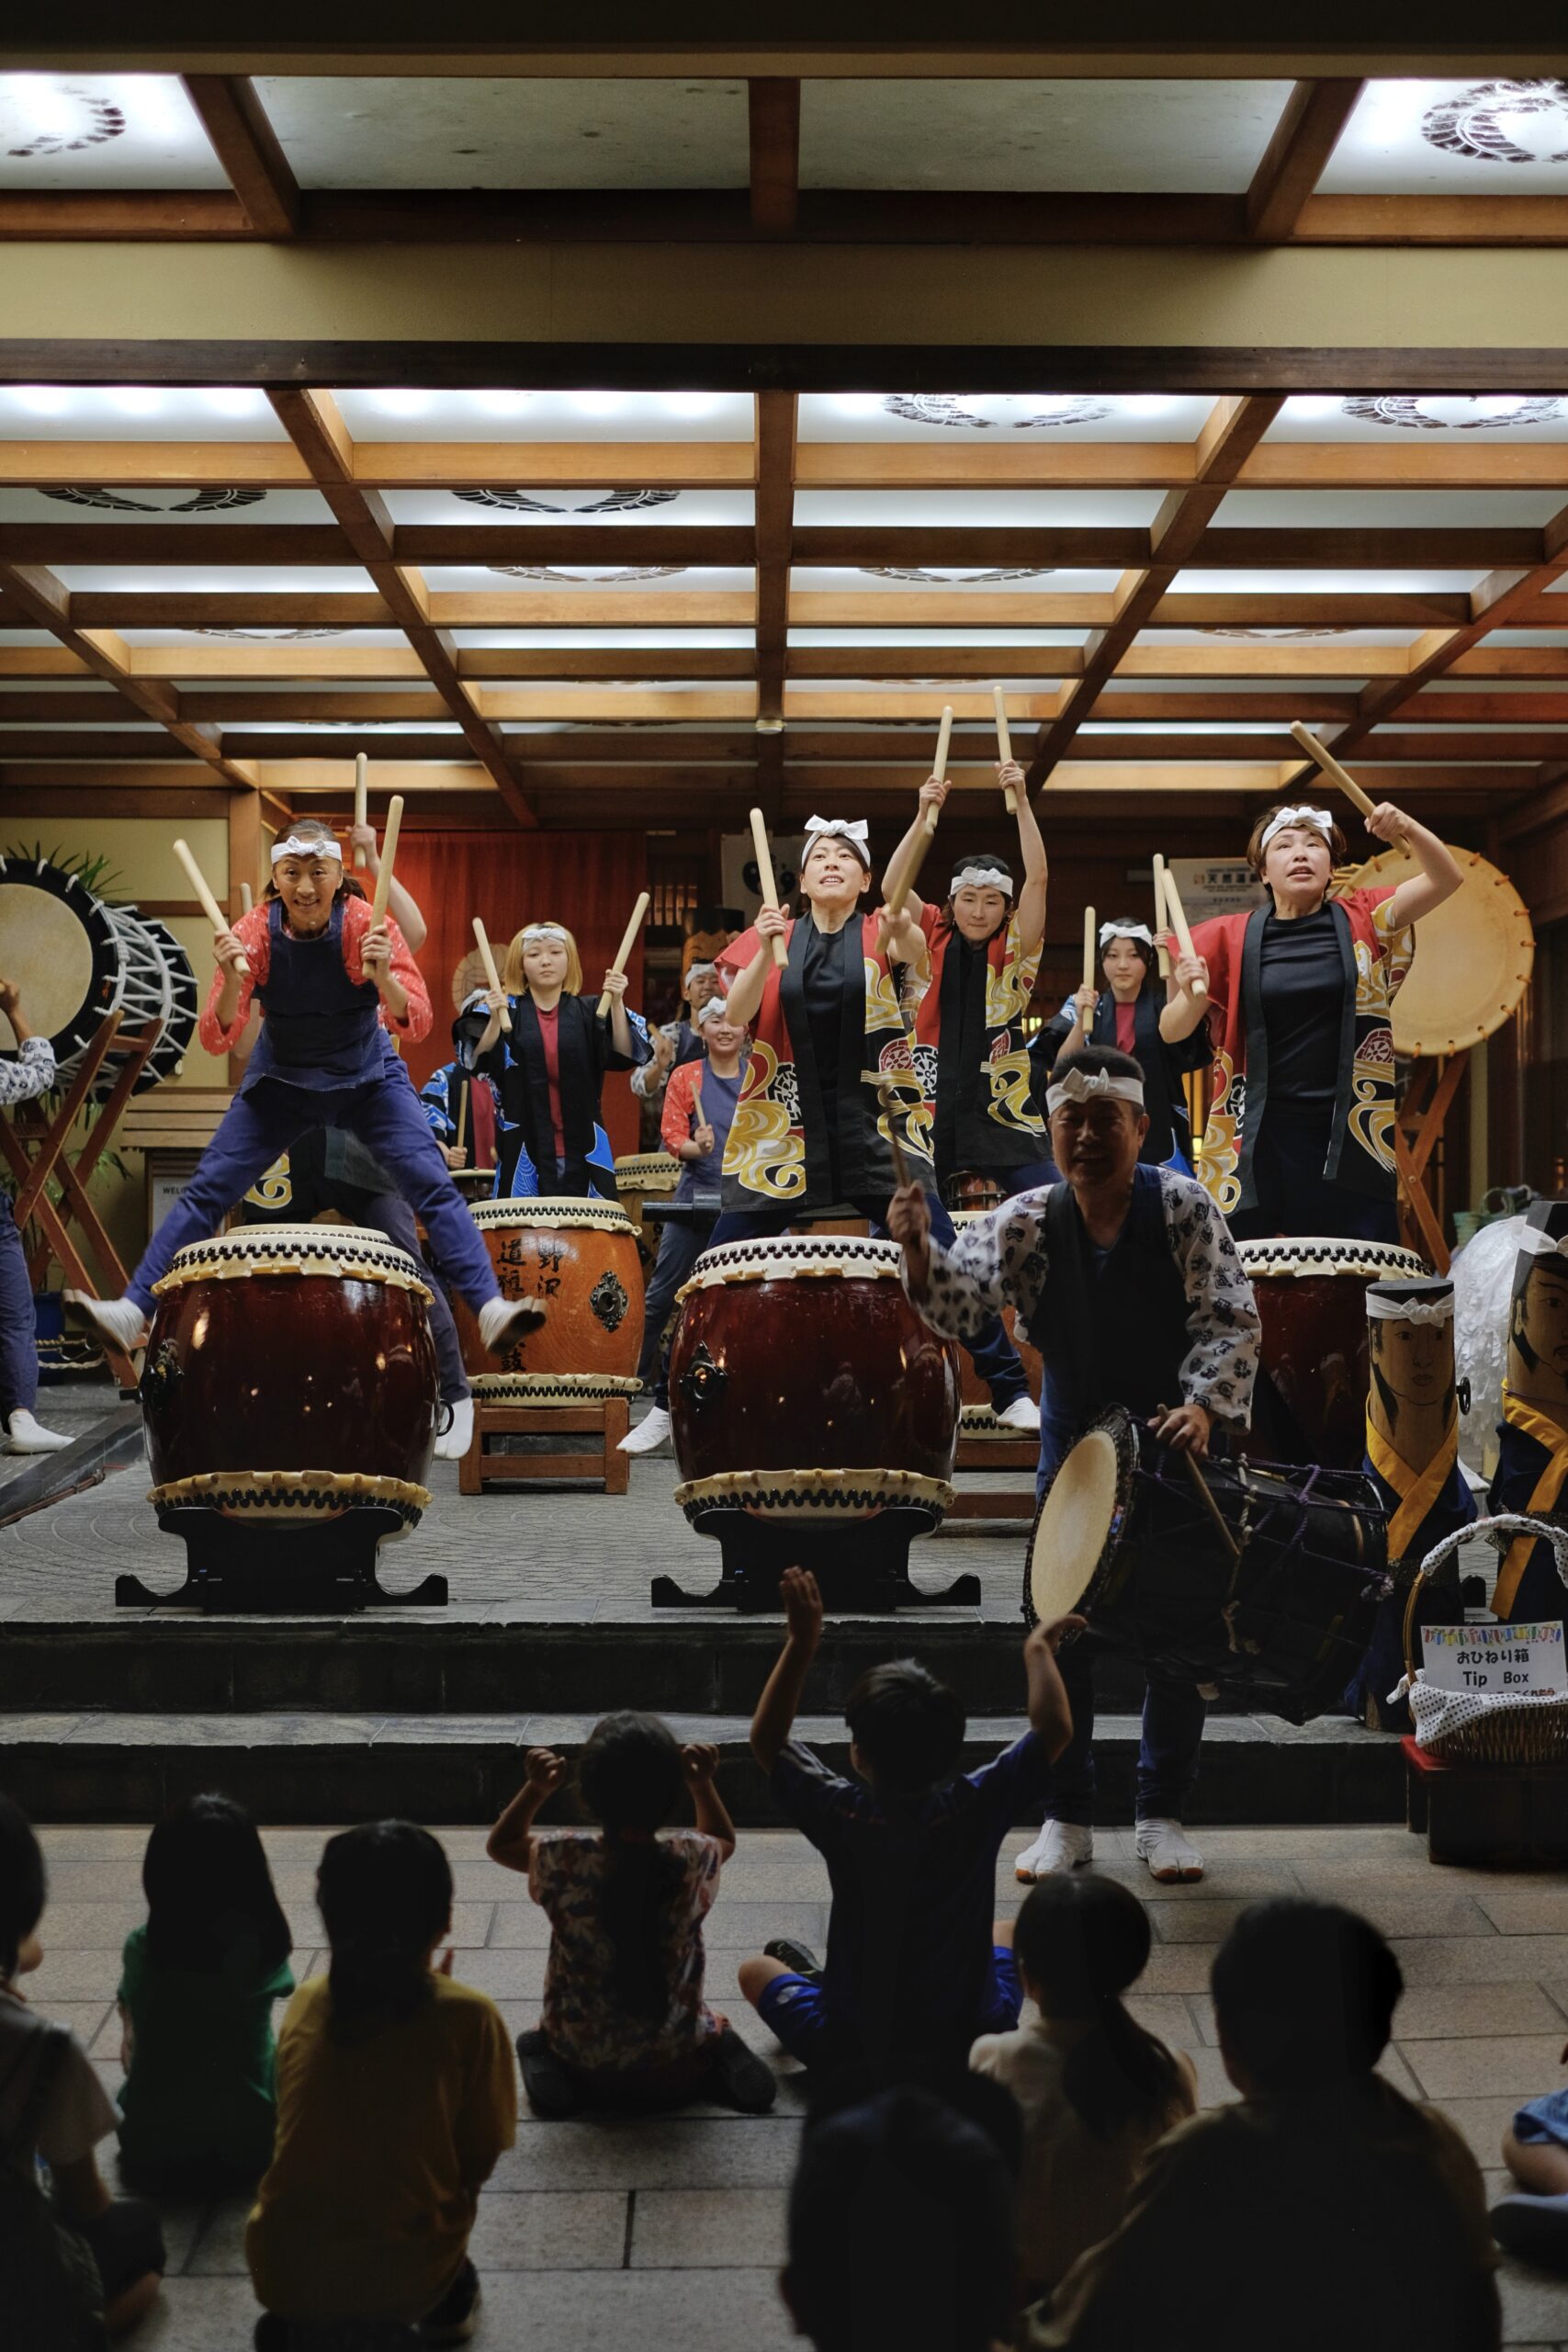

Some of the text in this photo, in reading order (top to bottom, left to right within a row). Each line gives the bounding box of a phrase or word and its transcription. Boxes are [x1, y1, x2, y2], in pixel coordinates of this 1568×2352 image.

[1457, 1648, 1529, 1664] おひねり箱
[1462, 1671, 1529, 1688] Tip Box
